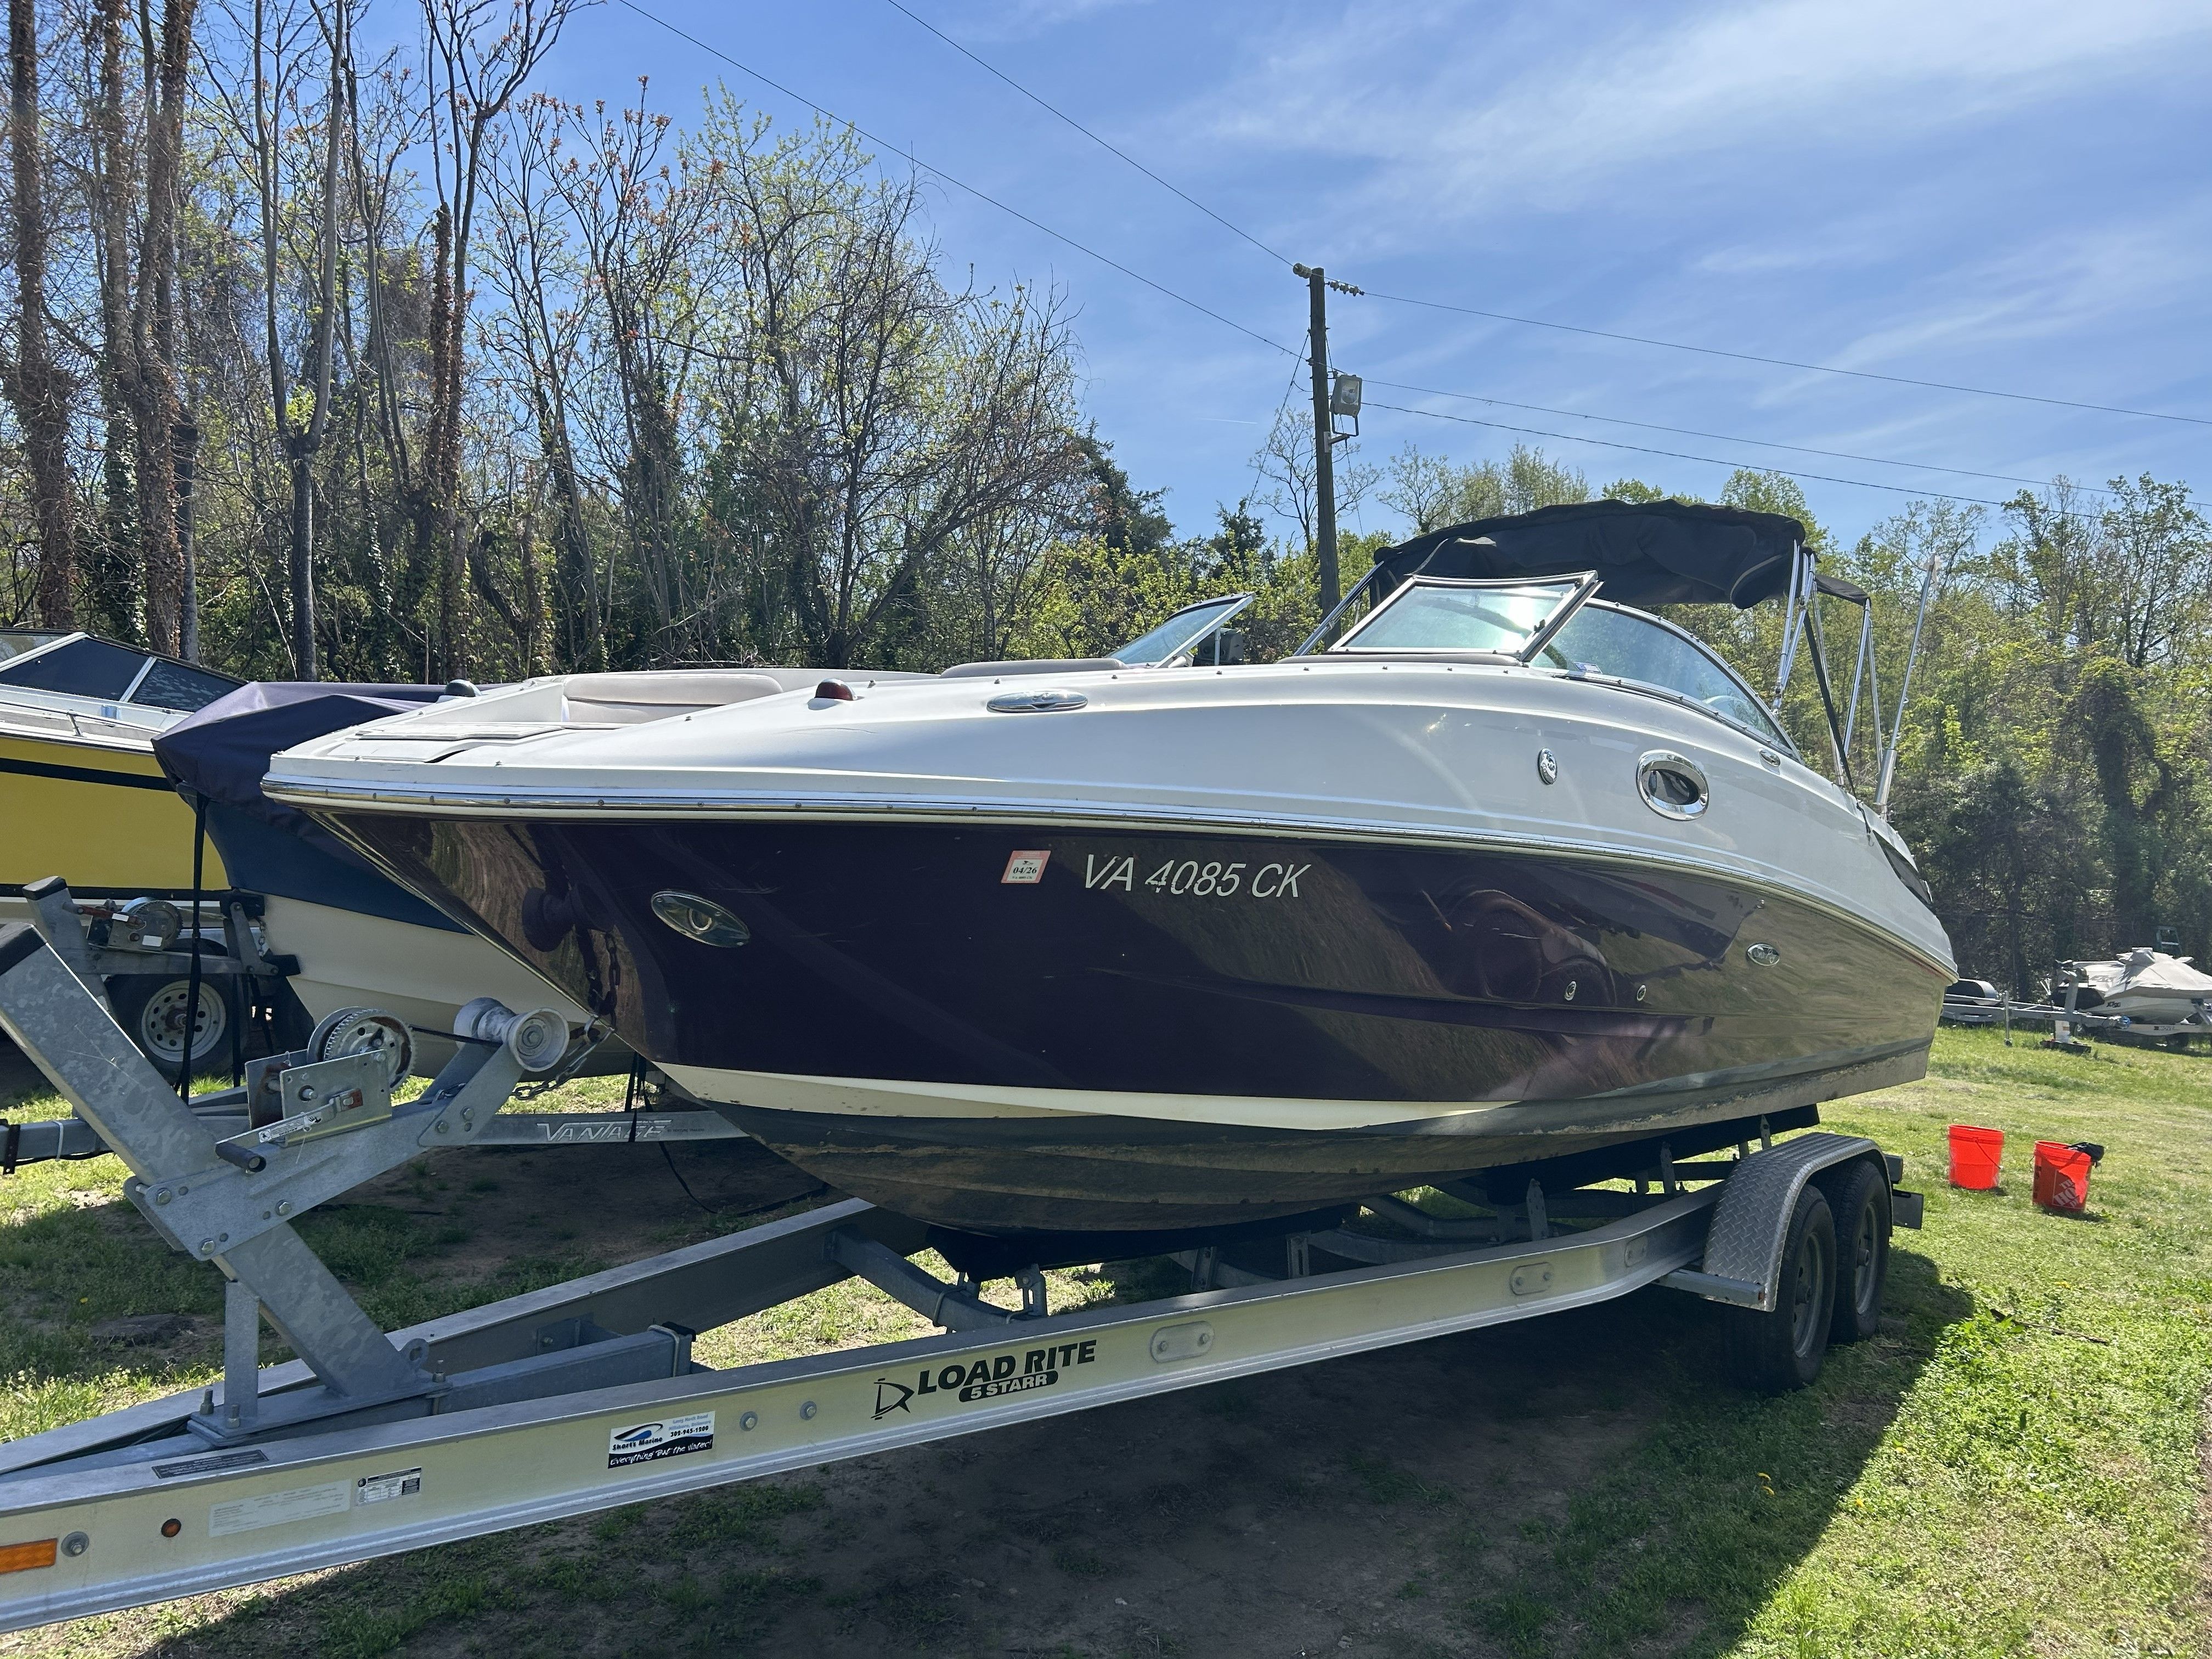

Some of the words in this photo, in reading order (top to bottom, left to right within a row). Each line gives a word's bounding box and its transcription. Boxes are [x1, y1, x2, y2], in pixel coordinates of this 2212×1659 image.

[1084, 854, 1135, 891] VA
[1145, 860, 1246, 896] 4085
[1251, 864, 1312, 898] CK
[918, 1355, 1016, 1395] LOAD
[1024, 1339, 1097, 1374] RITE
[970, 1387, 981, 1400] 5
[986, 1374, 1047, 1396] STARR
[610, 1451, 653, 1465] Everything
[673, 1444, 686, 1454] the
[639, 1437, 663, 1446] Marine
